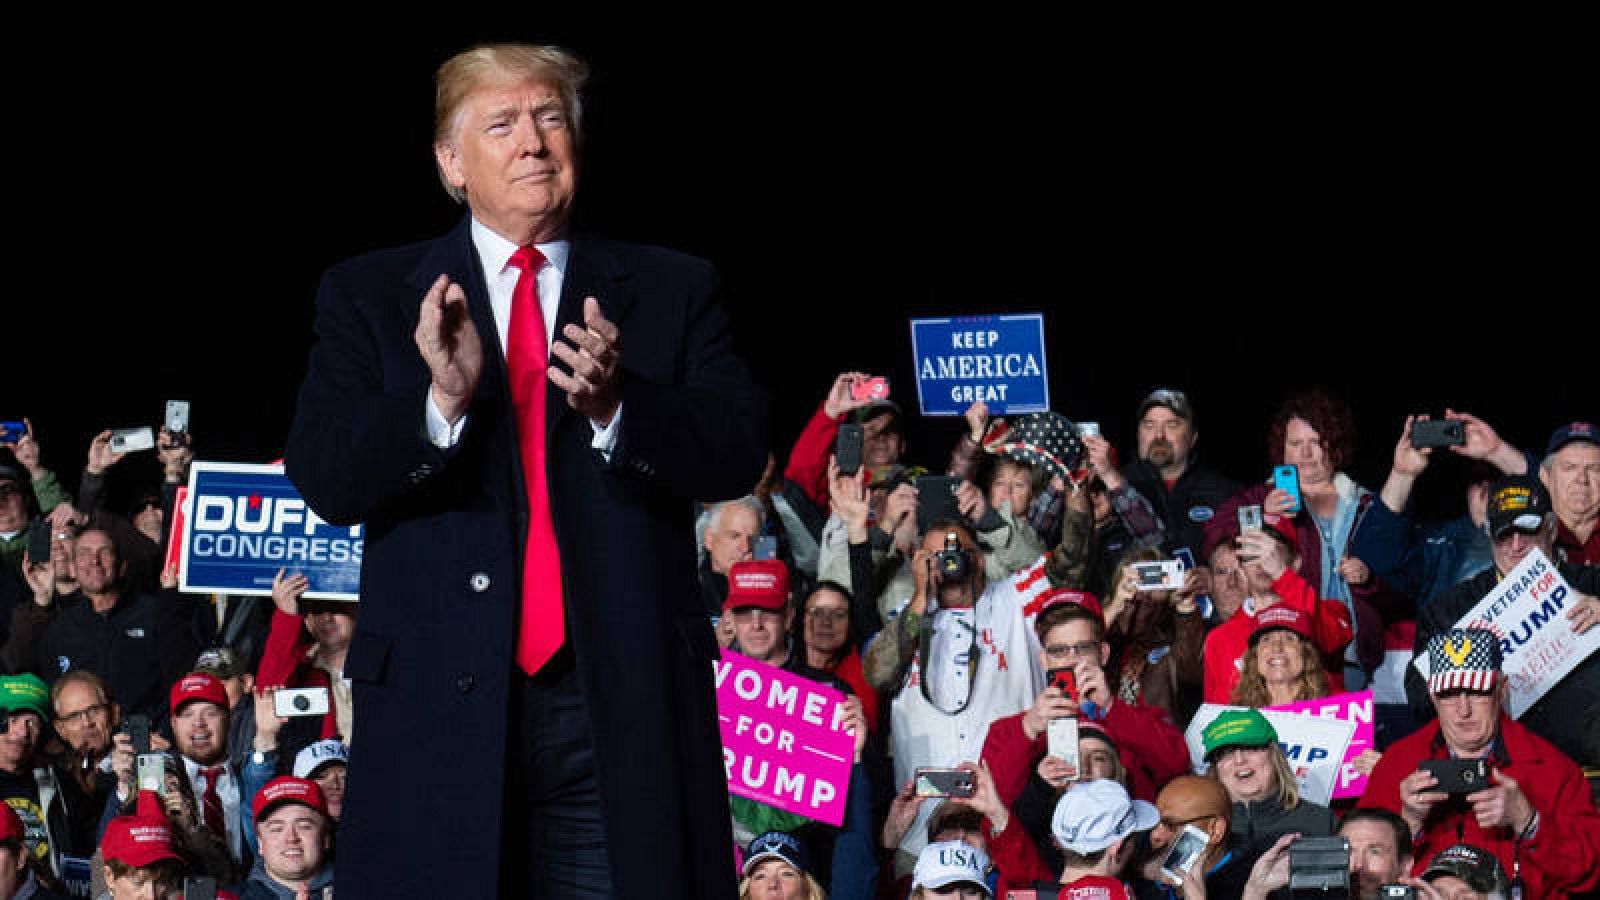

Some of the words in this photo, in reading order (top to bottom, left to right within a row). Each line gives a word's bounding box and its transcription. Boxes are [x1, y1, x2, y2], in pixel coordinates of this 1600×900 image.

[952, 330, 998, 348] KEEP
[921, 352, 1040, 379] AMERICA
[951, 384, 1008, 402] GREAT
[194, 495, 361, 536] DUFF
[1482, 559, 1547, 623] VETERANS
[1529, 571, 1557, 600] FOR
[1500, 585, 1567, 654] RUMP
[736, 714, 795, 753] FOR
[723, 746, 836, 808] RUMP
[939, 848, 979, 871] USA
